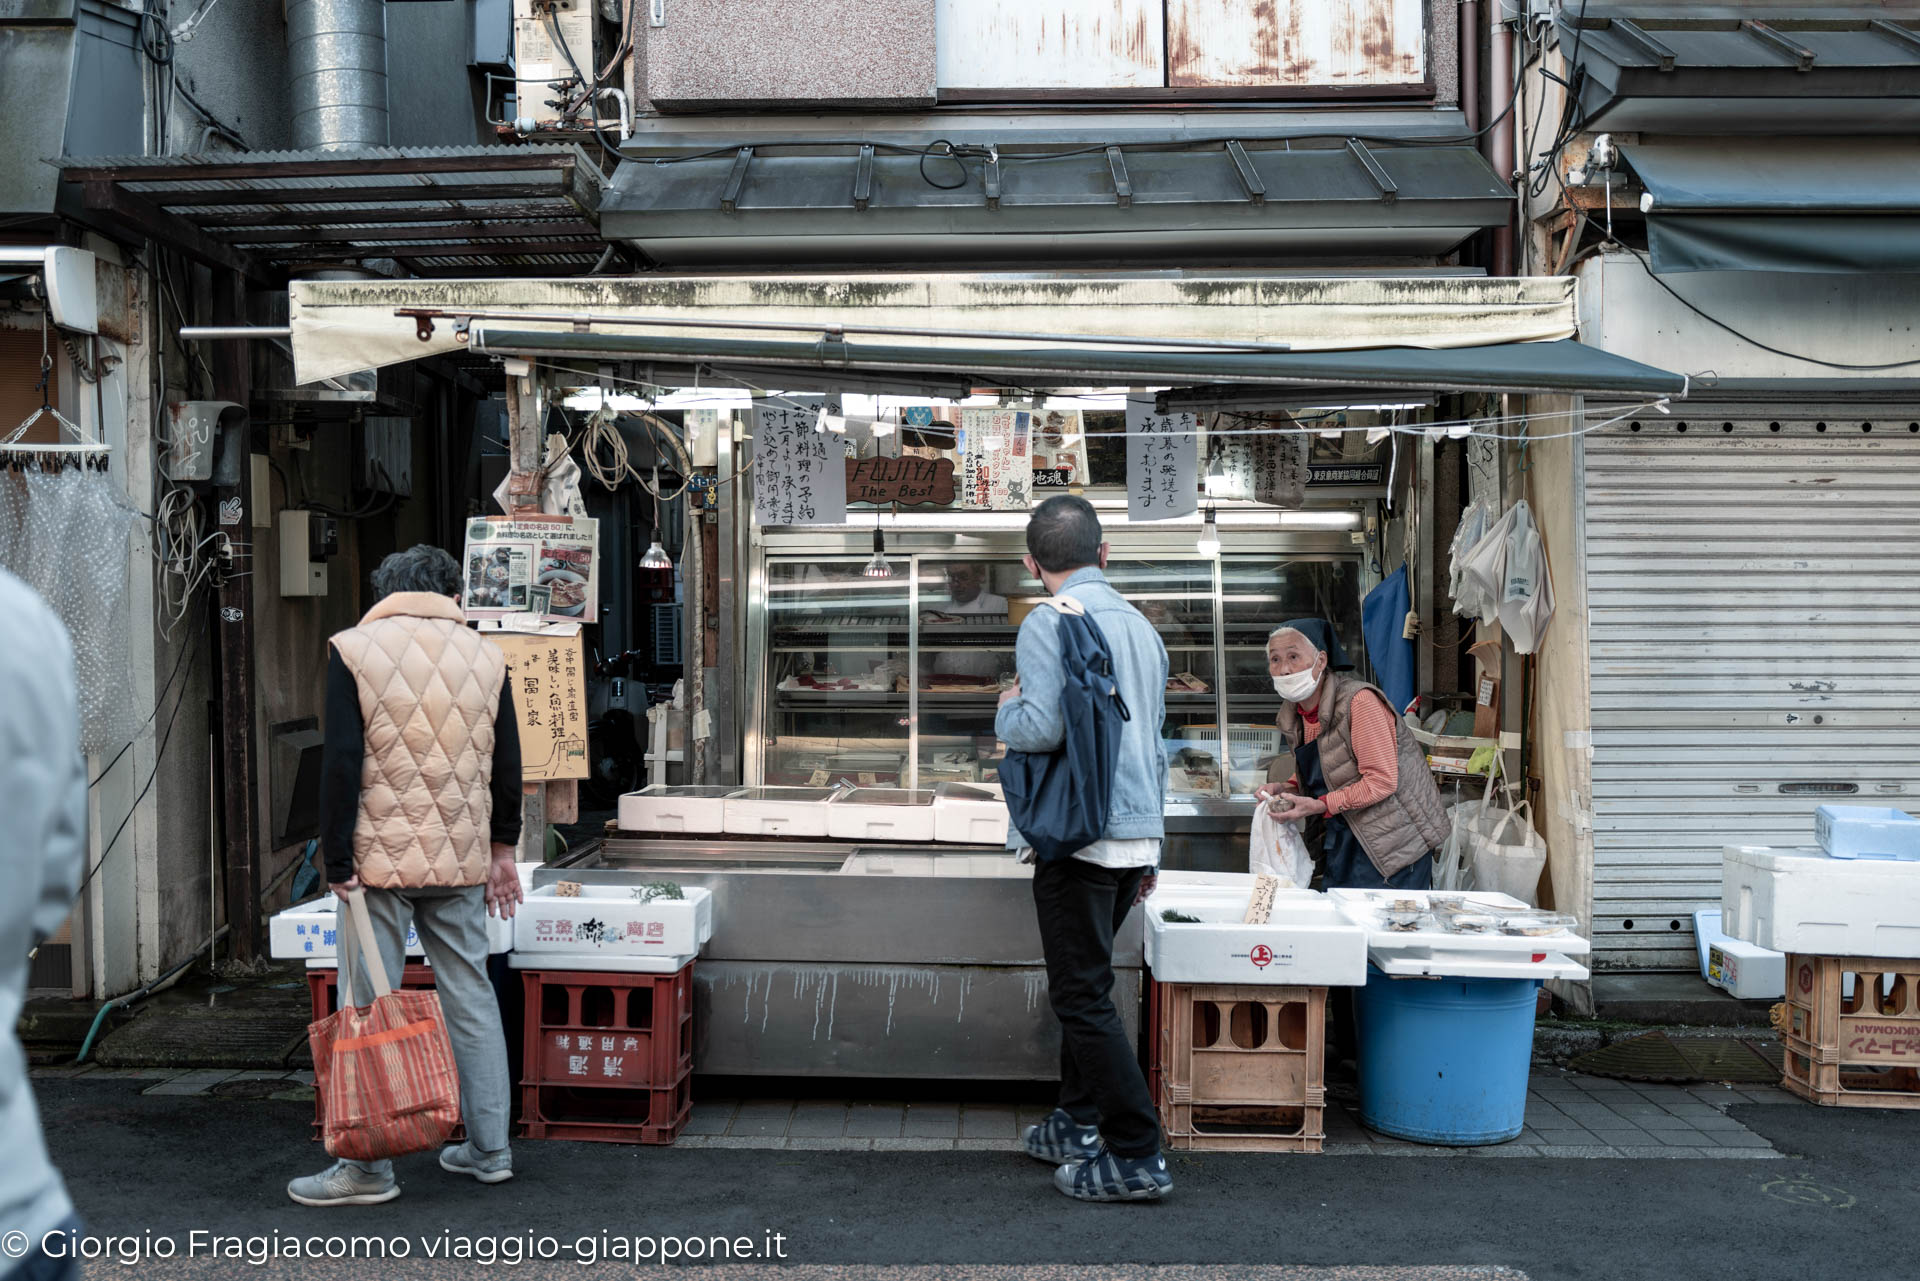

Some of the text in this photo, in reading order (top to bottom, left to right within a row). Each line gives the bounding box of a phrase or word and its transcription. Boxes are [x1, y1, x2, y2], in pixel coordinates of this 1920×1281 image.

[778, 409, 797, 525] 十二月より承ります
[793, 406, 815, 520] お節料理の予約
[852, 460, 938, 482] FUJIYA
[860, 484, 935, 498] The Best
[1138, 416, 1157, 508] 承っております
[547, 648, 566, 739] 美味しい魚料理
[568, 1055, 623, 1077] 清酒
